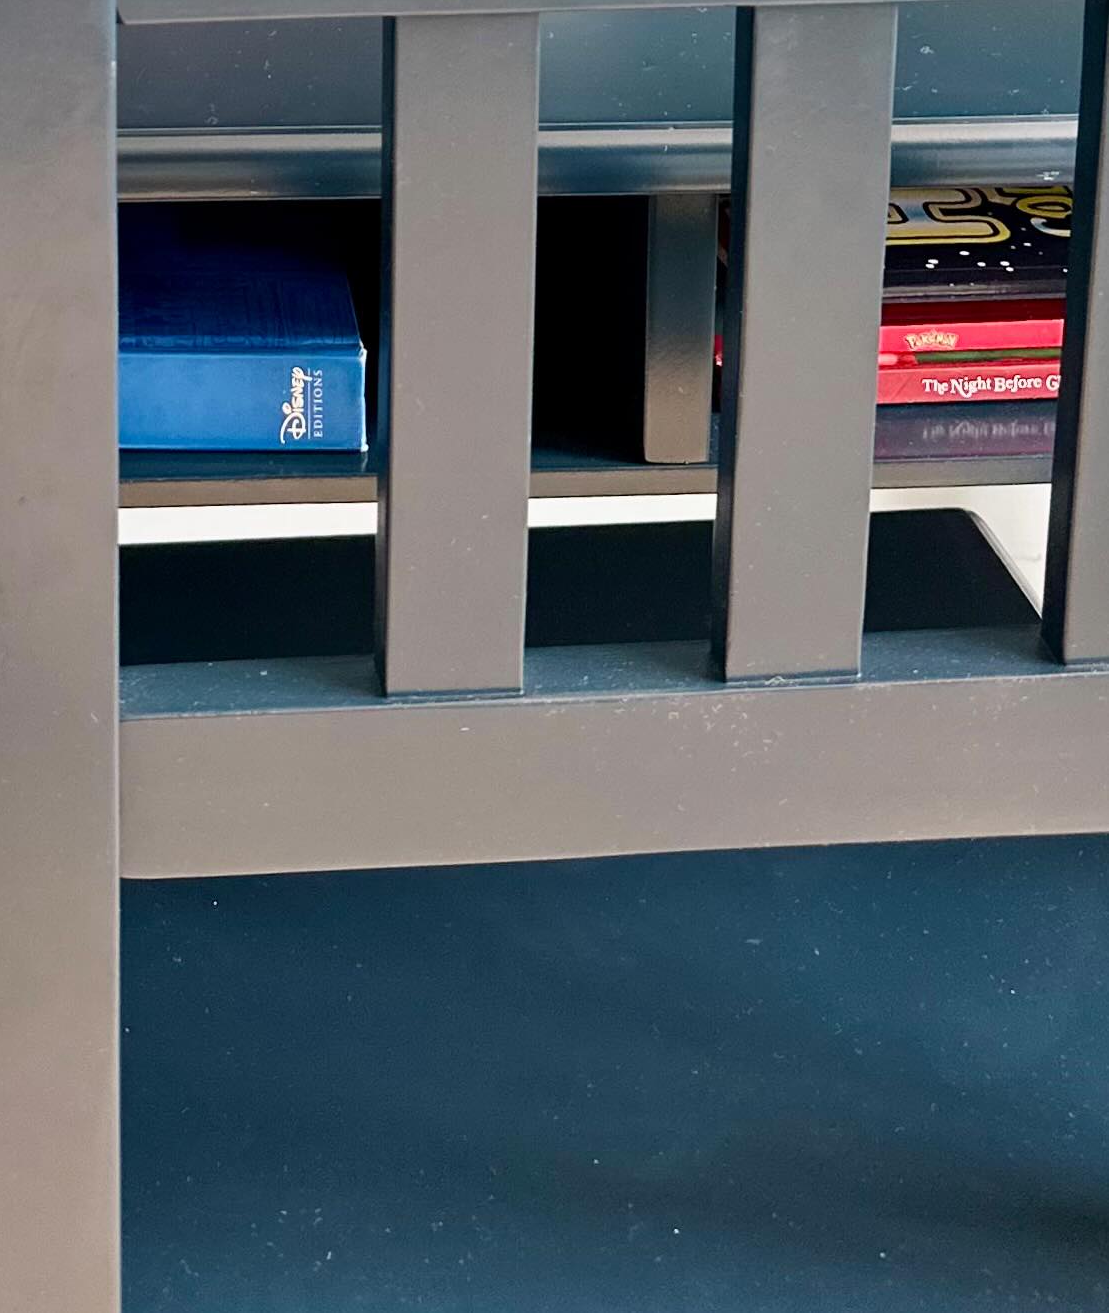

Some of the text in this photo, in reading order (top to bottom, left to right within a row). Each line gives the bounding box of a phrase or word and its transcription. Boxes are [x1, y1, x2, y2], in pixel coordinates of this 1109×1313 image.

[313, 369, 323, 438] EDITIONS
[922, 378, 948, 395] The
[949, 376, 991, 398] Night
[994, 375, 1041, 393] Before
